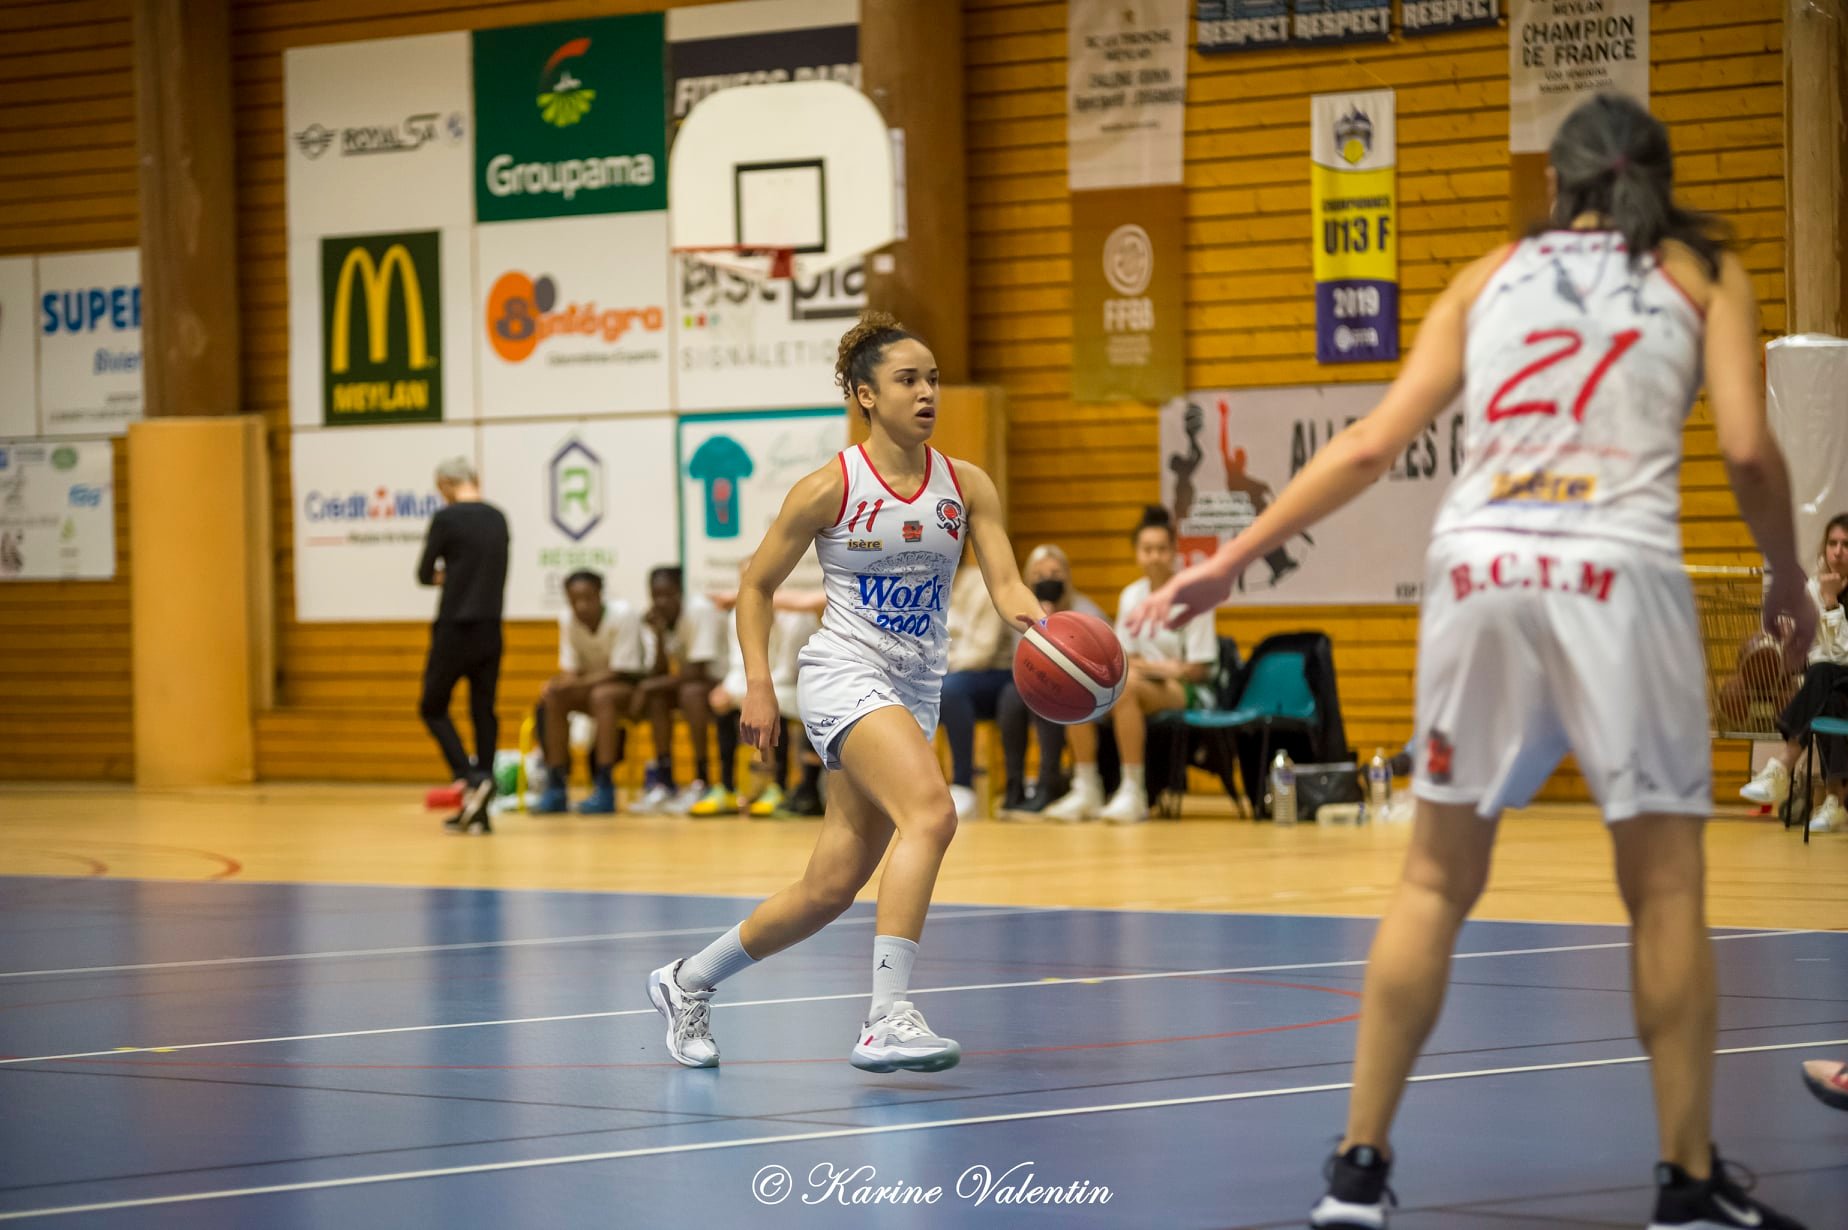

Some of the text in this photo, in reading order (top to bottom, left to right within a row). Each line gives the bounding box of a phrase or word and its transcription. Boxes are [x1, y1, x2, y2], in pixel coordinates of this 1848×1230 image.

[1294, 8, 1390, 40] RESPECT
[1402, 0, 1499, 28] RESPECT
[1522, 16, 1635, 44] CHAMPION
[1197, 16, 1289, 46] RESPECT
[1522, 39, 1637, 67] DE FRANCE
[486, 154, 655, 200] Groupama
[1324, 215, 1390, 255] U13 F
[1485, 329, 1641, 423] 21
[333, 378, 429, 413] MEYLAN
[848, 498, 885, 533] 11
[848, 538, 882, 550] isère
[856, 574, 943, 612] Work
[876, 613, 931, 638] 2000
